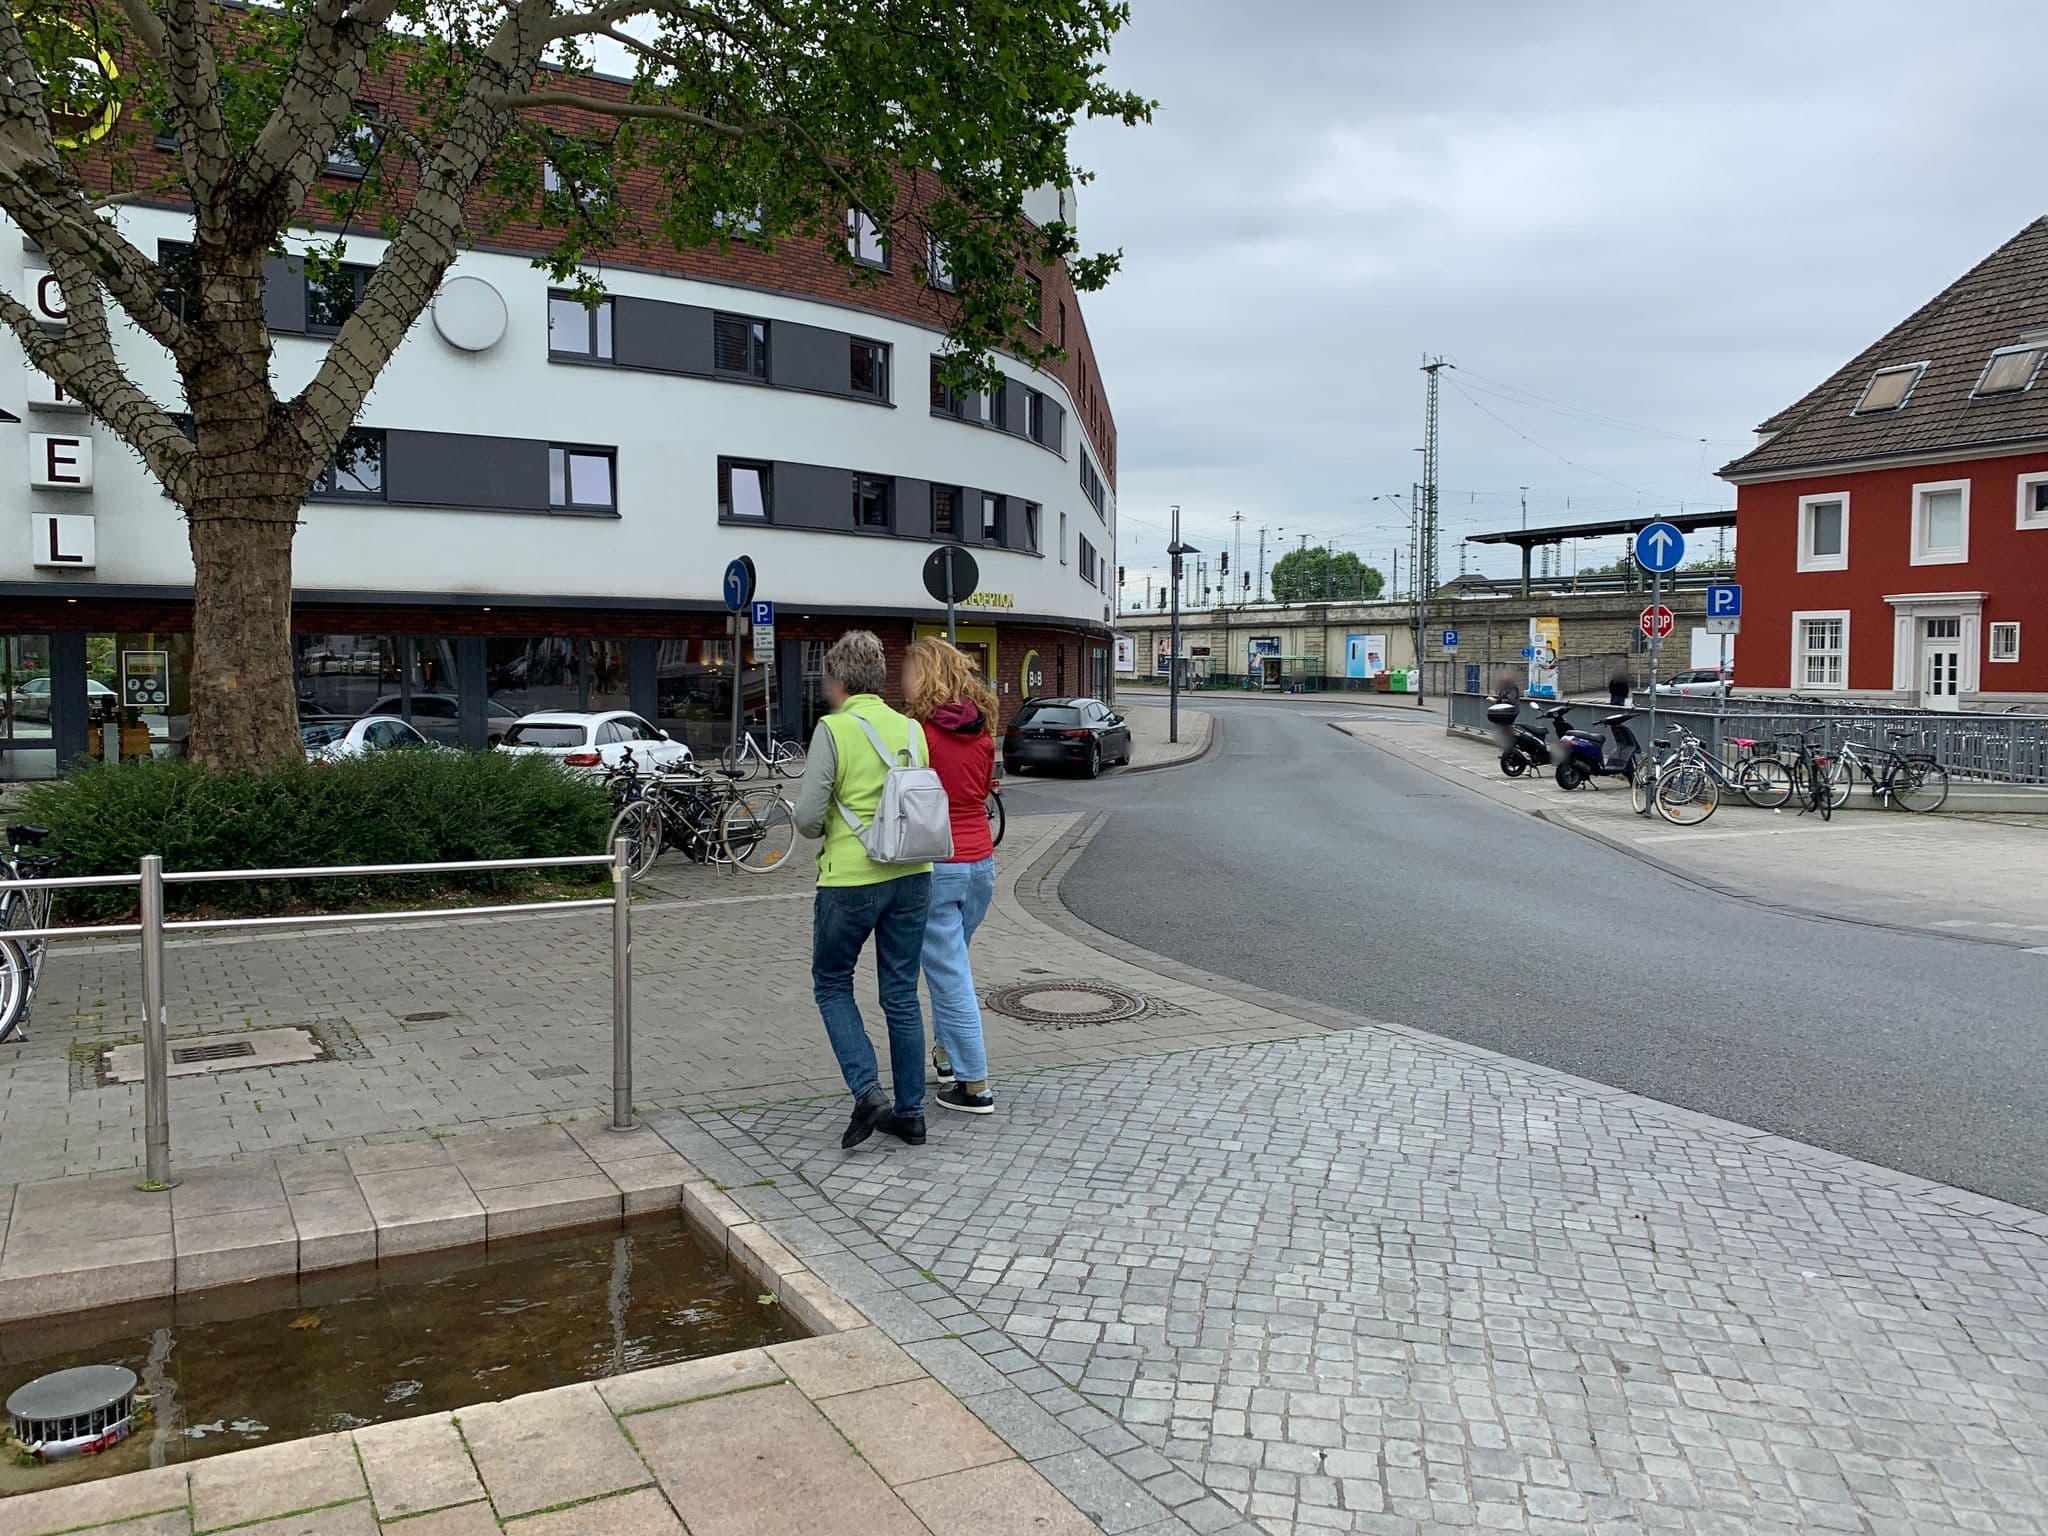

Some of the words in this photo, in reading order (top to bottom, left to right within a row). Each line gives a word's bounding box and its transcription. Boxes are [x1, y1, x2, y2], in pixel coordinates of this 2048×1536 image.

[1715, 589, 1734, 613] P
[757, 603, 768, 621] P
[1446, 632, 1454, 644] P
